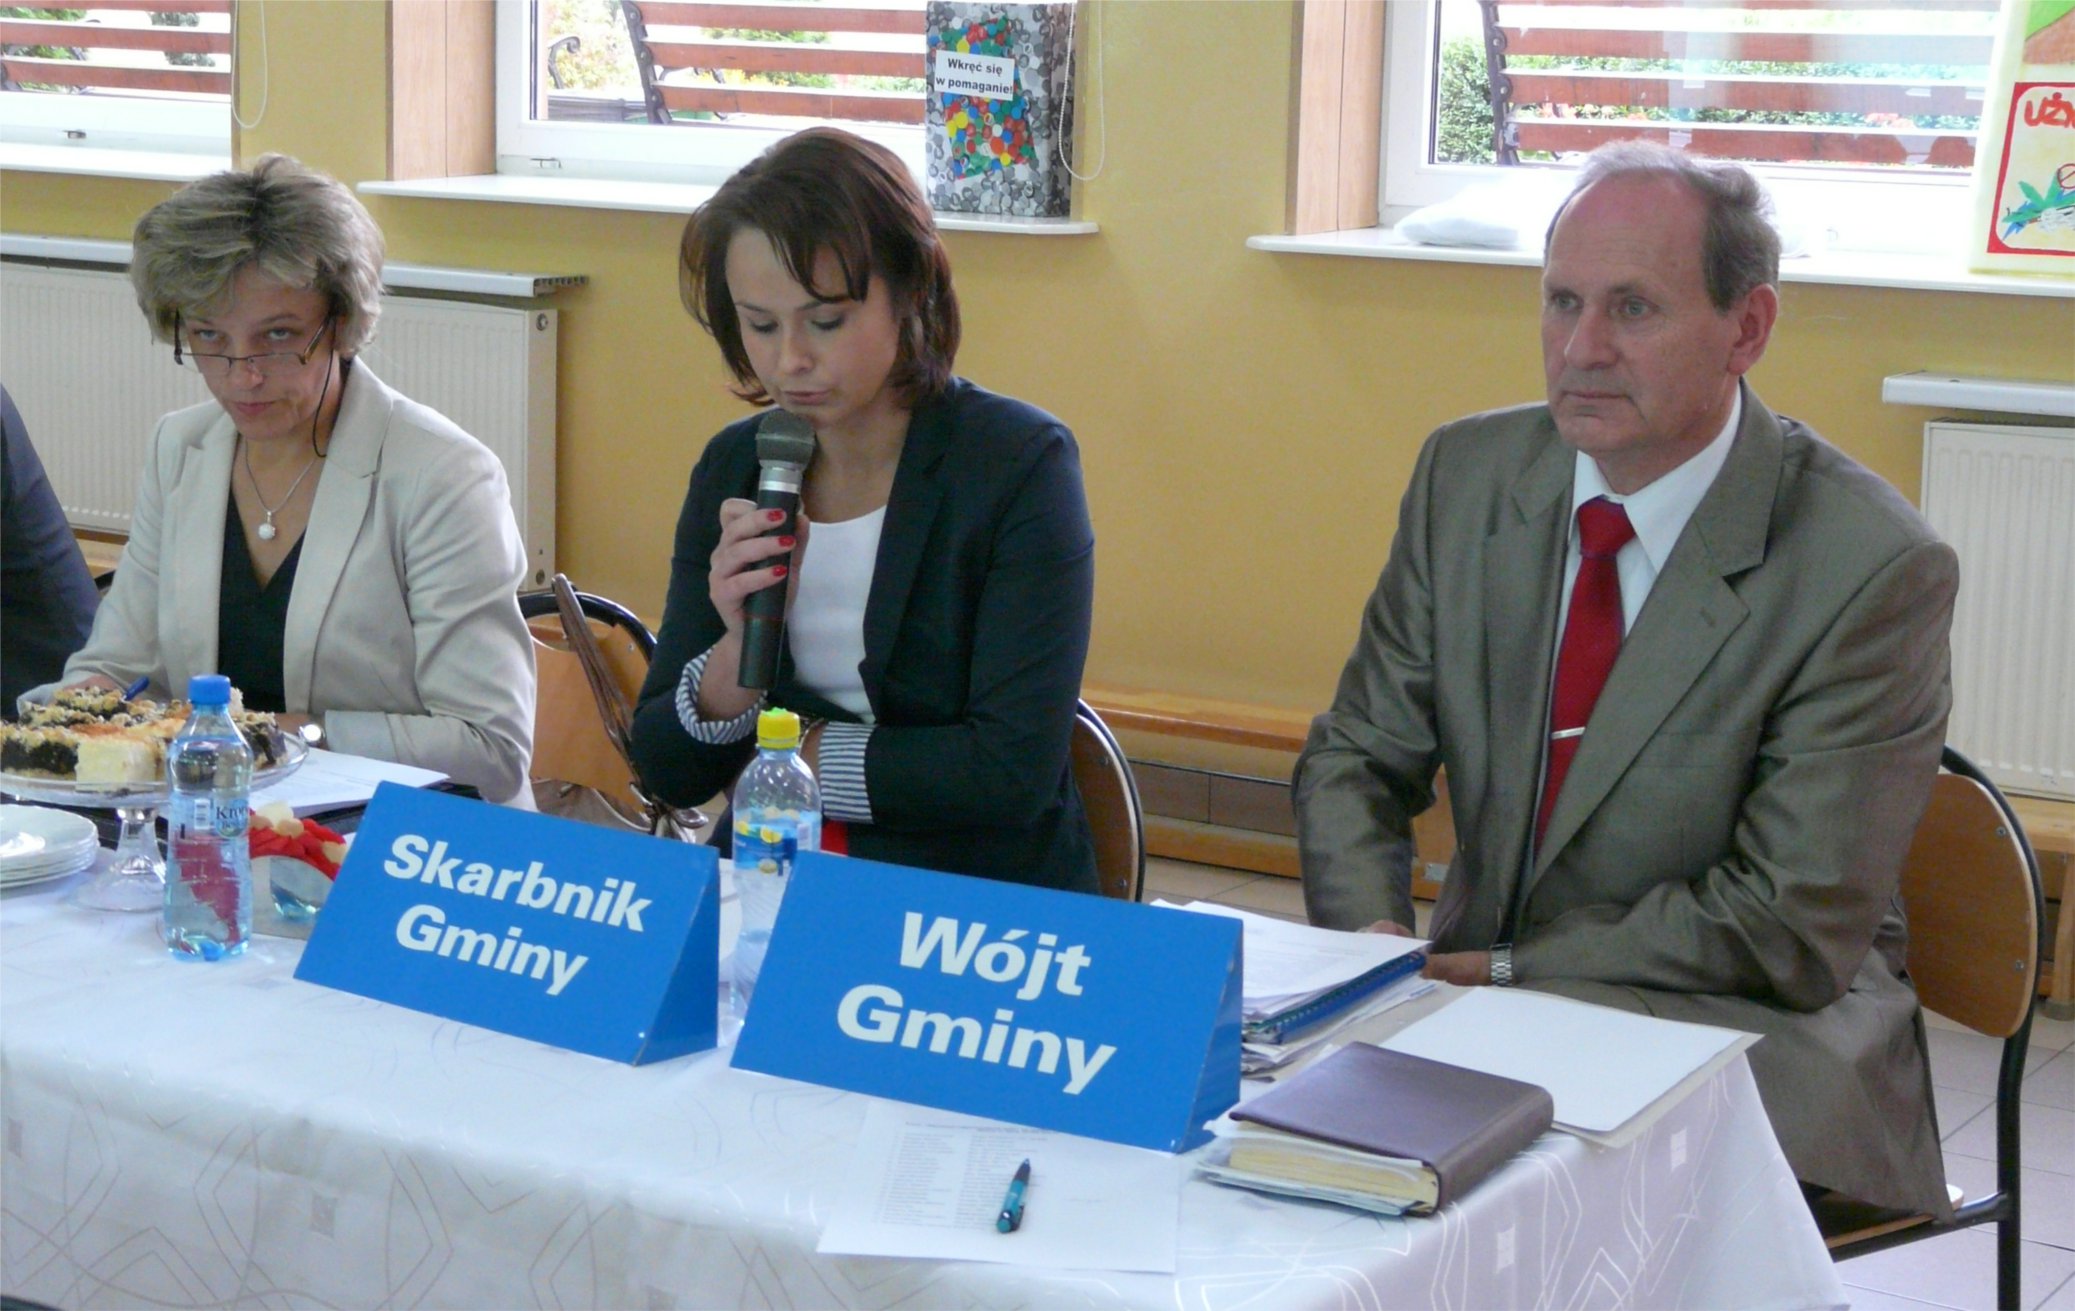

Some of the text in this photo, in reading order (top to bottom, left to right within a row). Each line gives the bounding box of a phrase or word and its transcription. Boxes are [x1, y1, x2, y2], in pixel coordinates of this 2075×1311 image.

[936, 77, 1013, 95] w pomaganie!
[948, 58, 1003, 77] Wkręć się
[383, 834, 652, 932] Skarbnik
[395, 904, 588, 996] Gminy
[900, 911, 1091, 1001] Wójt
[836, 984, 1117, 1096] Gminy
